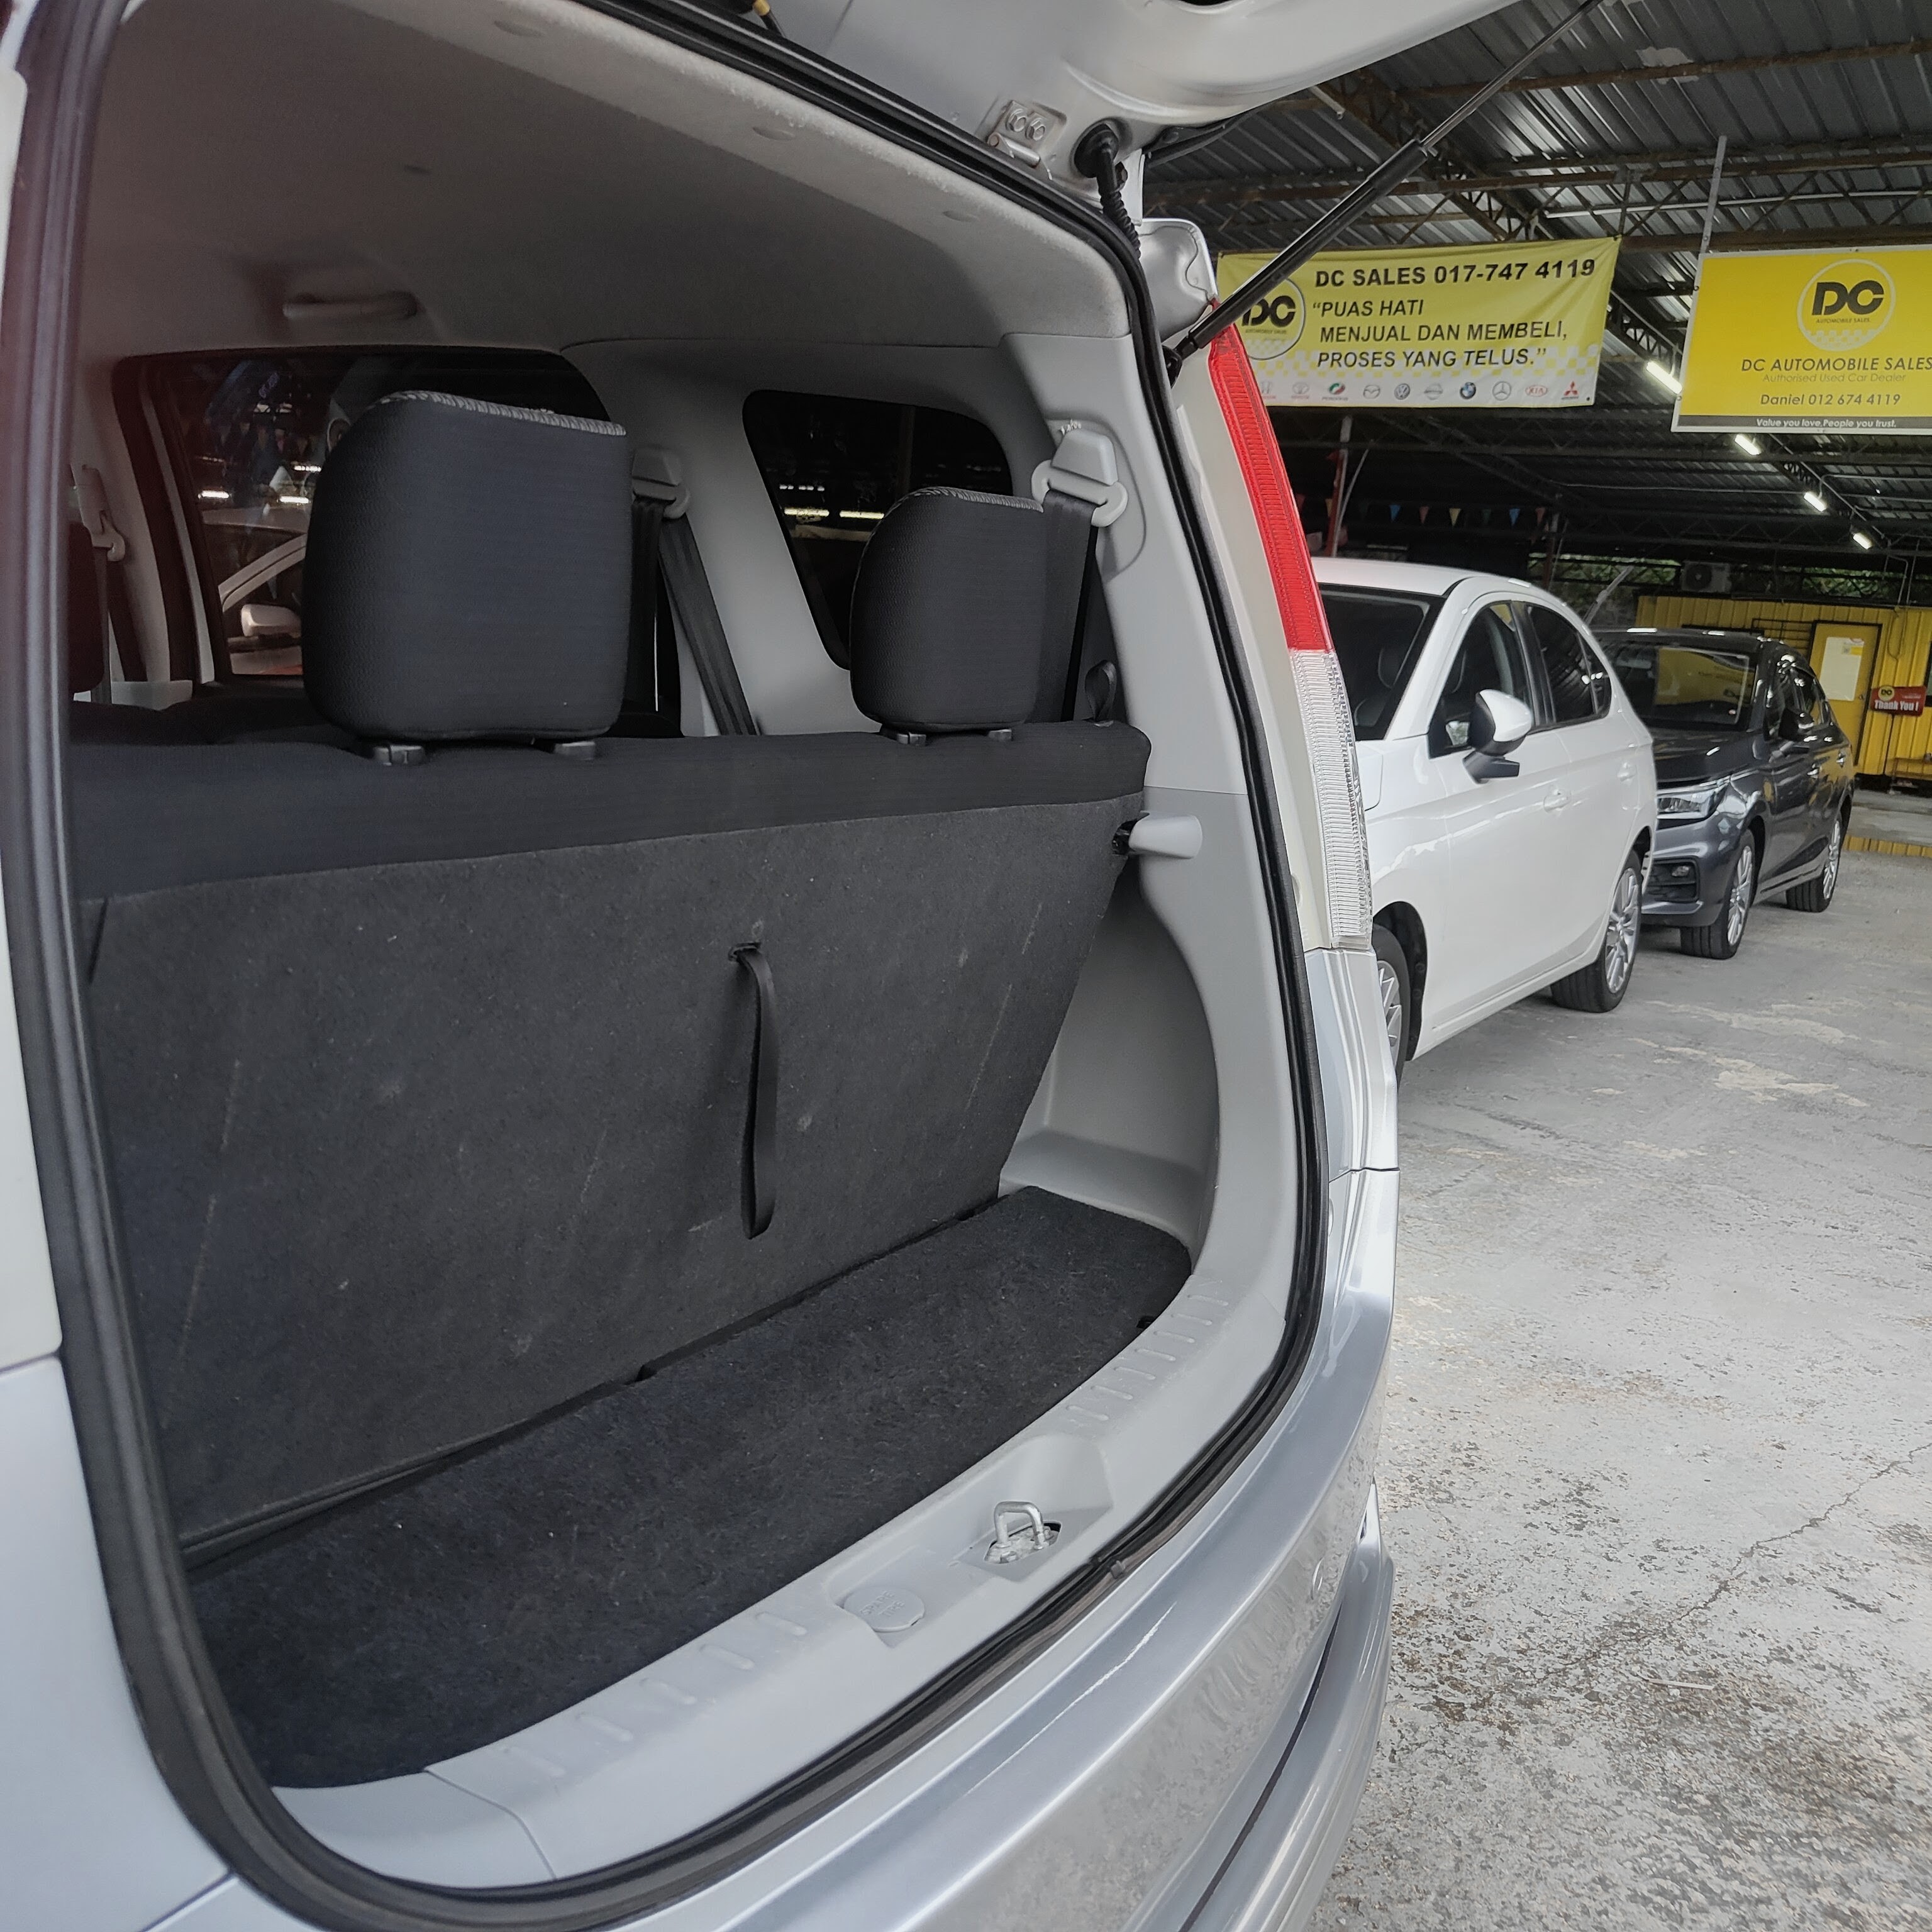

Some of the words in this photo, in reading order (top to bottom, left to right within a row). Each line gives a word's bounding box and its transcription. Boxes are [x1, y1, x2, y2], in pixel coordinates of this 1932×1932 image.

[1315, 270, 1345, 287] DC
[1352, 267, 1426, 286] SALES
[1434, 263, 1528, 284] 017-747
[1535, 259, 1595, 279] 4119
[1812, 280, 1884, 316] DC
[1379, 299, 1424, 316] HATI
[1320, 325, 1411, 343] MENJUAL
[1417, 324, 1460, 341] DAN
[1467, 321, 1567, 341] MEMBELI,
[1317, 351, 1396, 368] PROSES
[1402, 350, 1457, 367] YANG
[1741, 359, 1766, 371] DC
[1770, 358, 1879, 371] AUTOMOBILE
[1884, 357, 1932, 370] SALES
[1762, 373, 1817, 382] Authorised
[1819, 374, 1845, 382] Used
[1848, 373, 1868, 382] Car
[1870, 372, 1906, 382] Dealer
[1761, 394, 1805, 405] Daniel
[1808, 394, 1833, 405] 012
[1838, 394, 1862, 405] 674
[1867, 394, 1901, 405] 4119
[1757, 418, 1782, 427] Value
[1784, 420, 1800, 428] you
[1875, 419, 1897, 428] trust.
[1875, 699, 1898, 710] Thank
[860, 1591, 895, 1615] SPARE
[878, 1601, 906, 1618] TIRE
